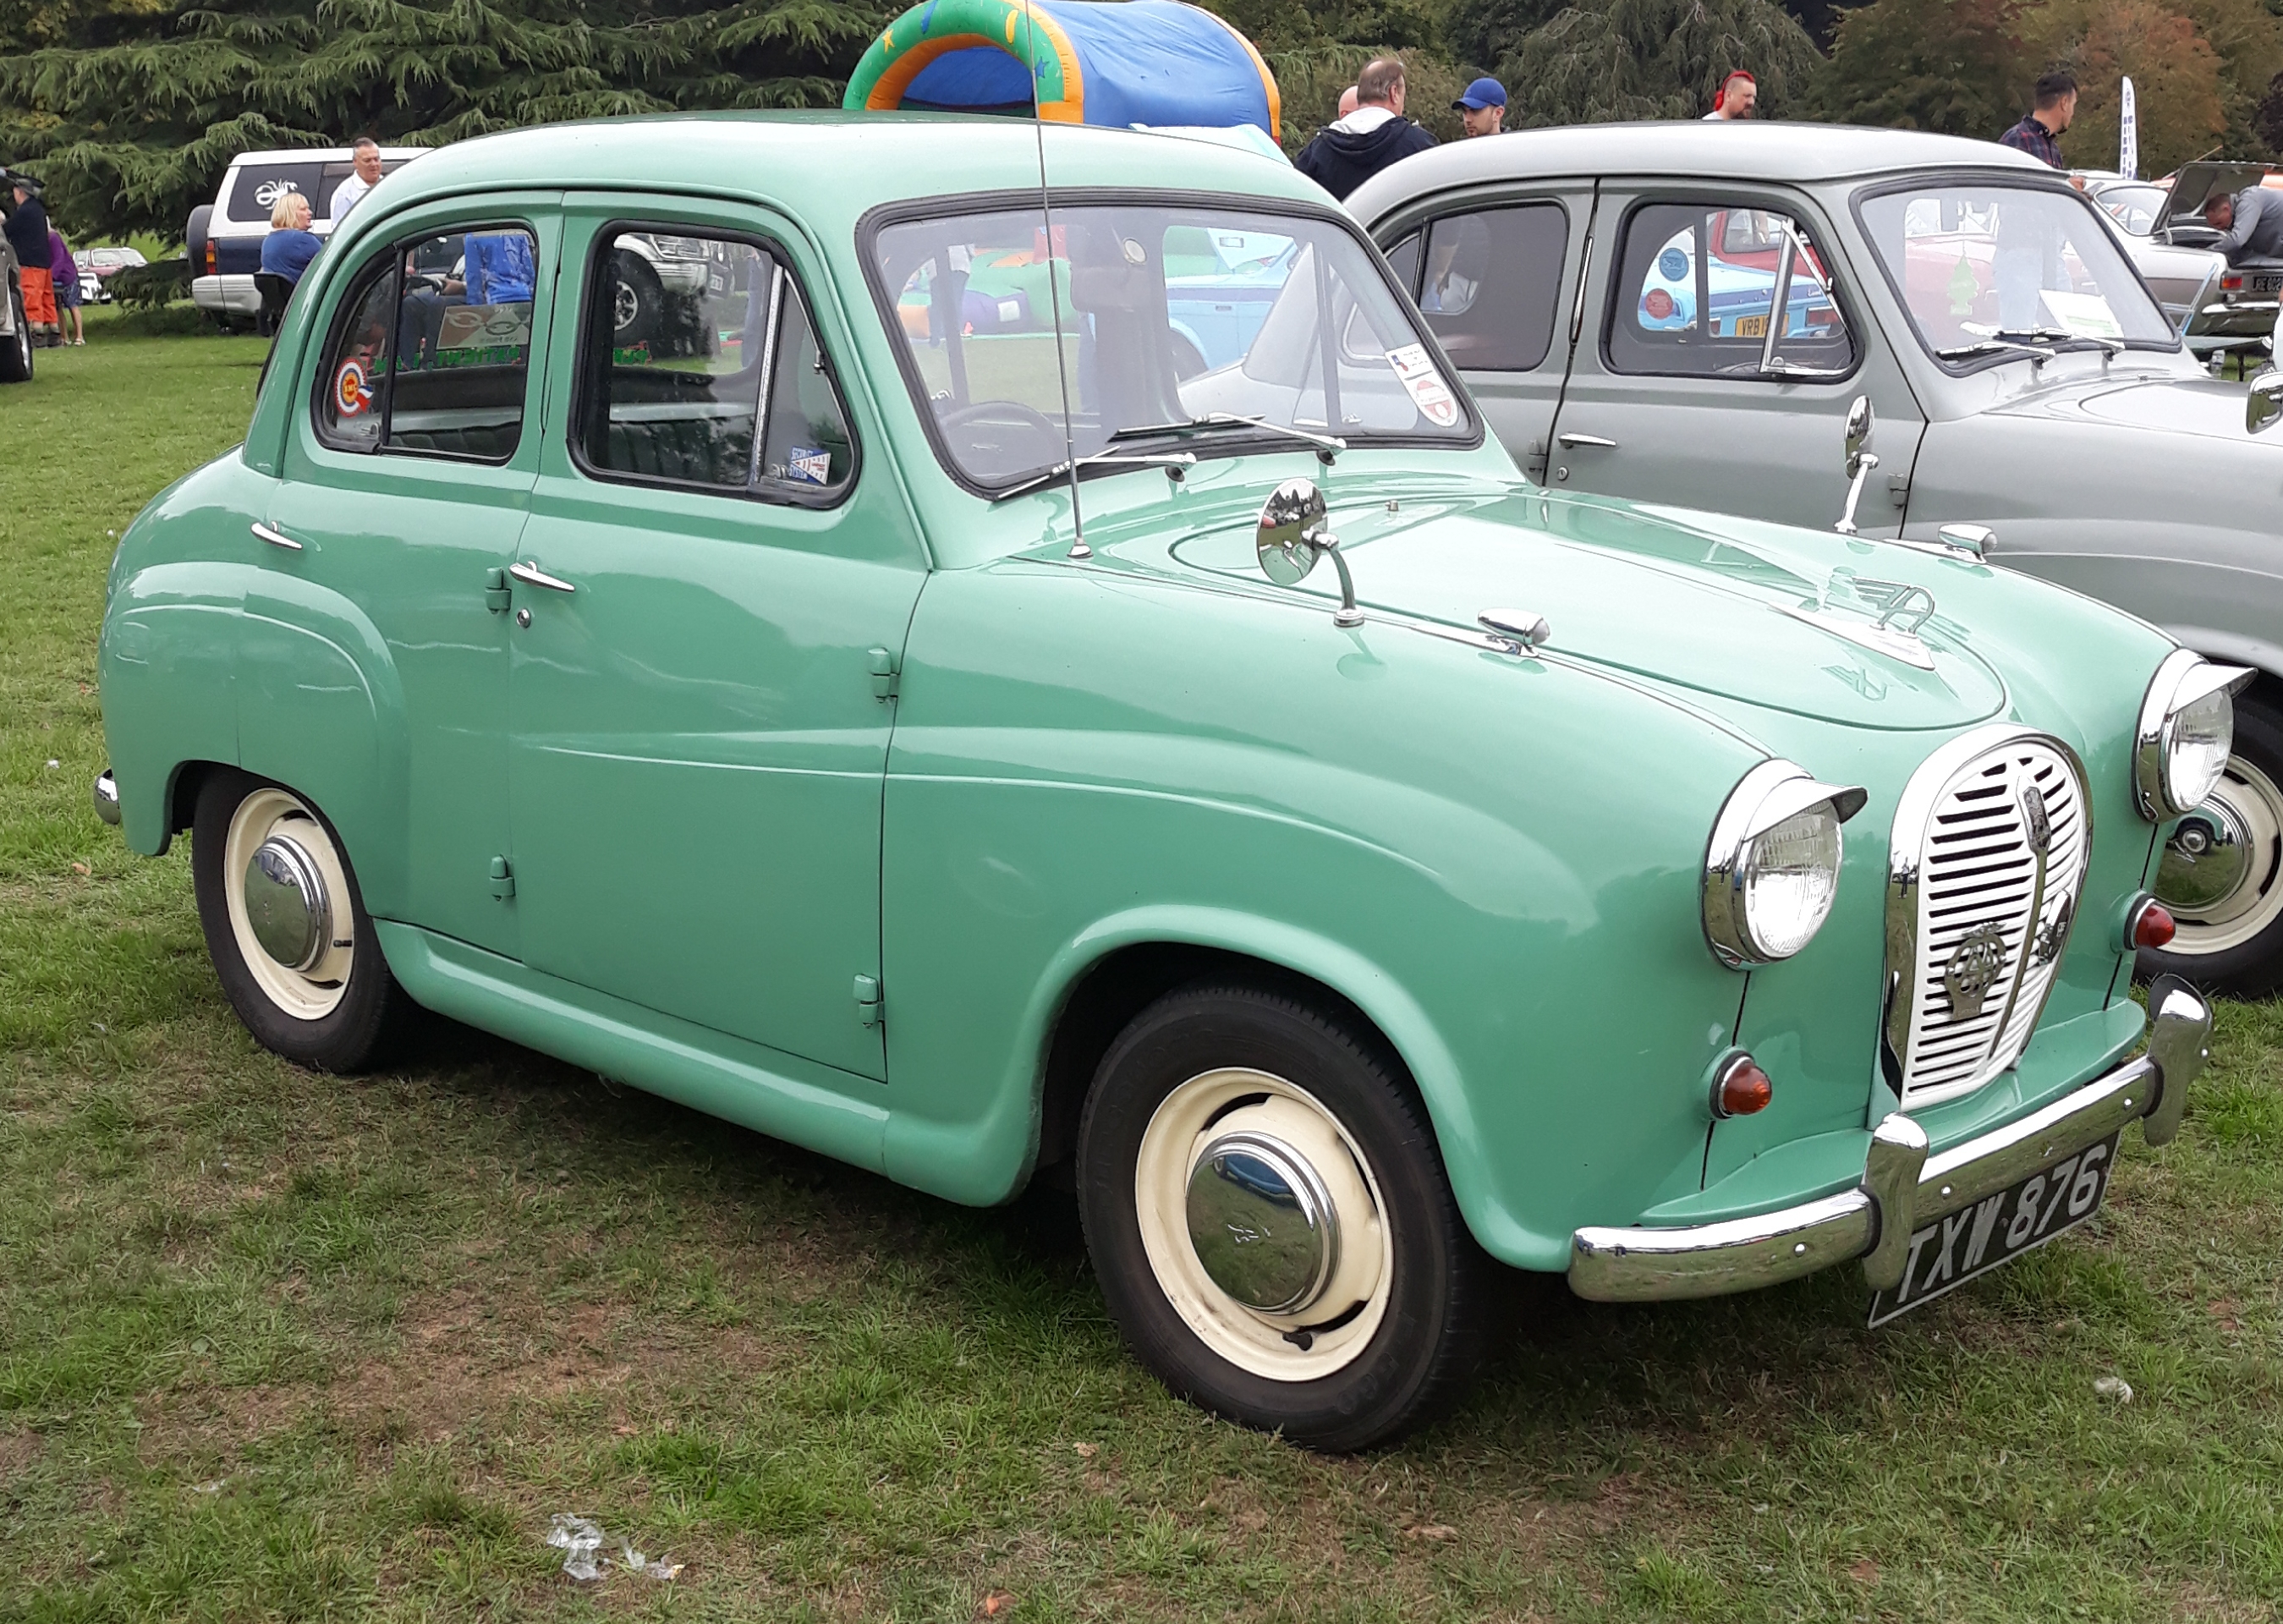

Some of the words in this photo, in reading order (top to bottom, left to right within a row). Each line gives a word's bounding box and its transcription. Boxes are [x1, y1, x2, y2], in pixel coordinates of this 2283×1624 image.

[1742, 318, 1761, 337] VRB
[1896, 1191, 2007, 1303] TXW
[2005, 1144, 2107, 1248] 876
